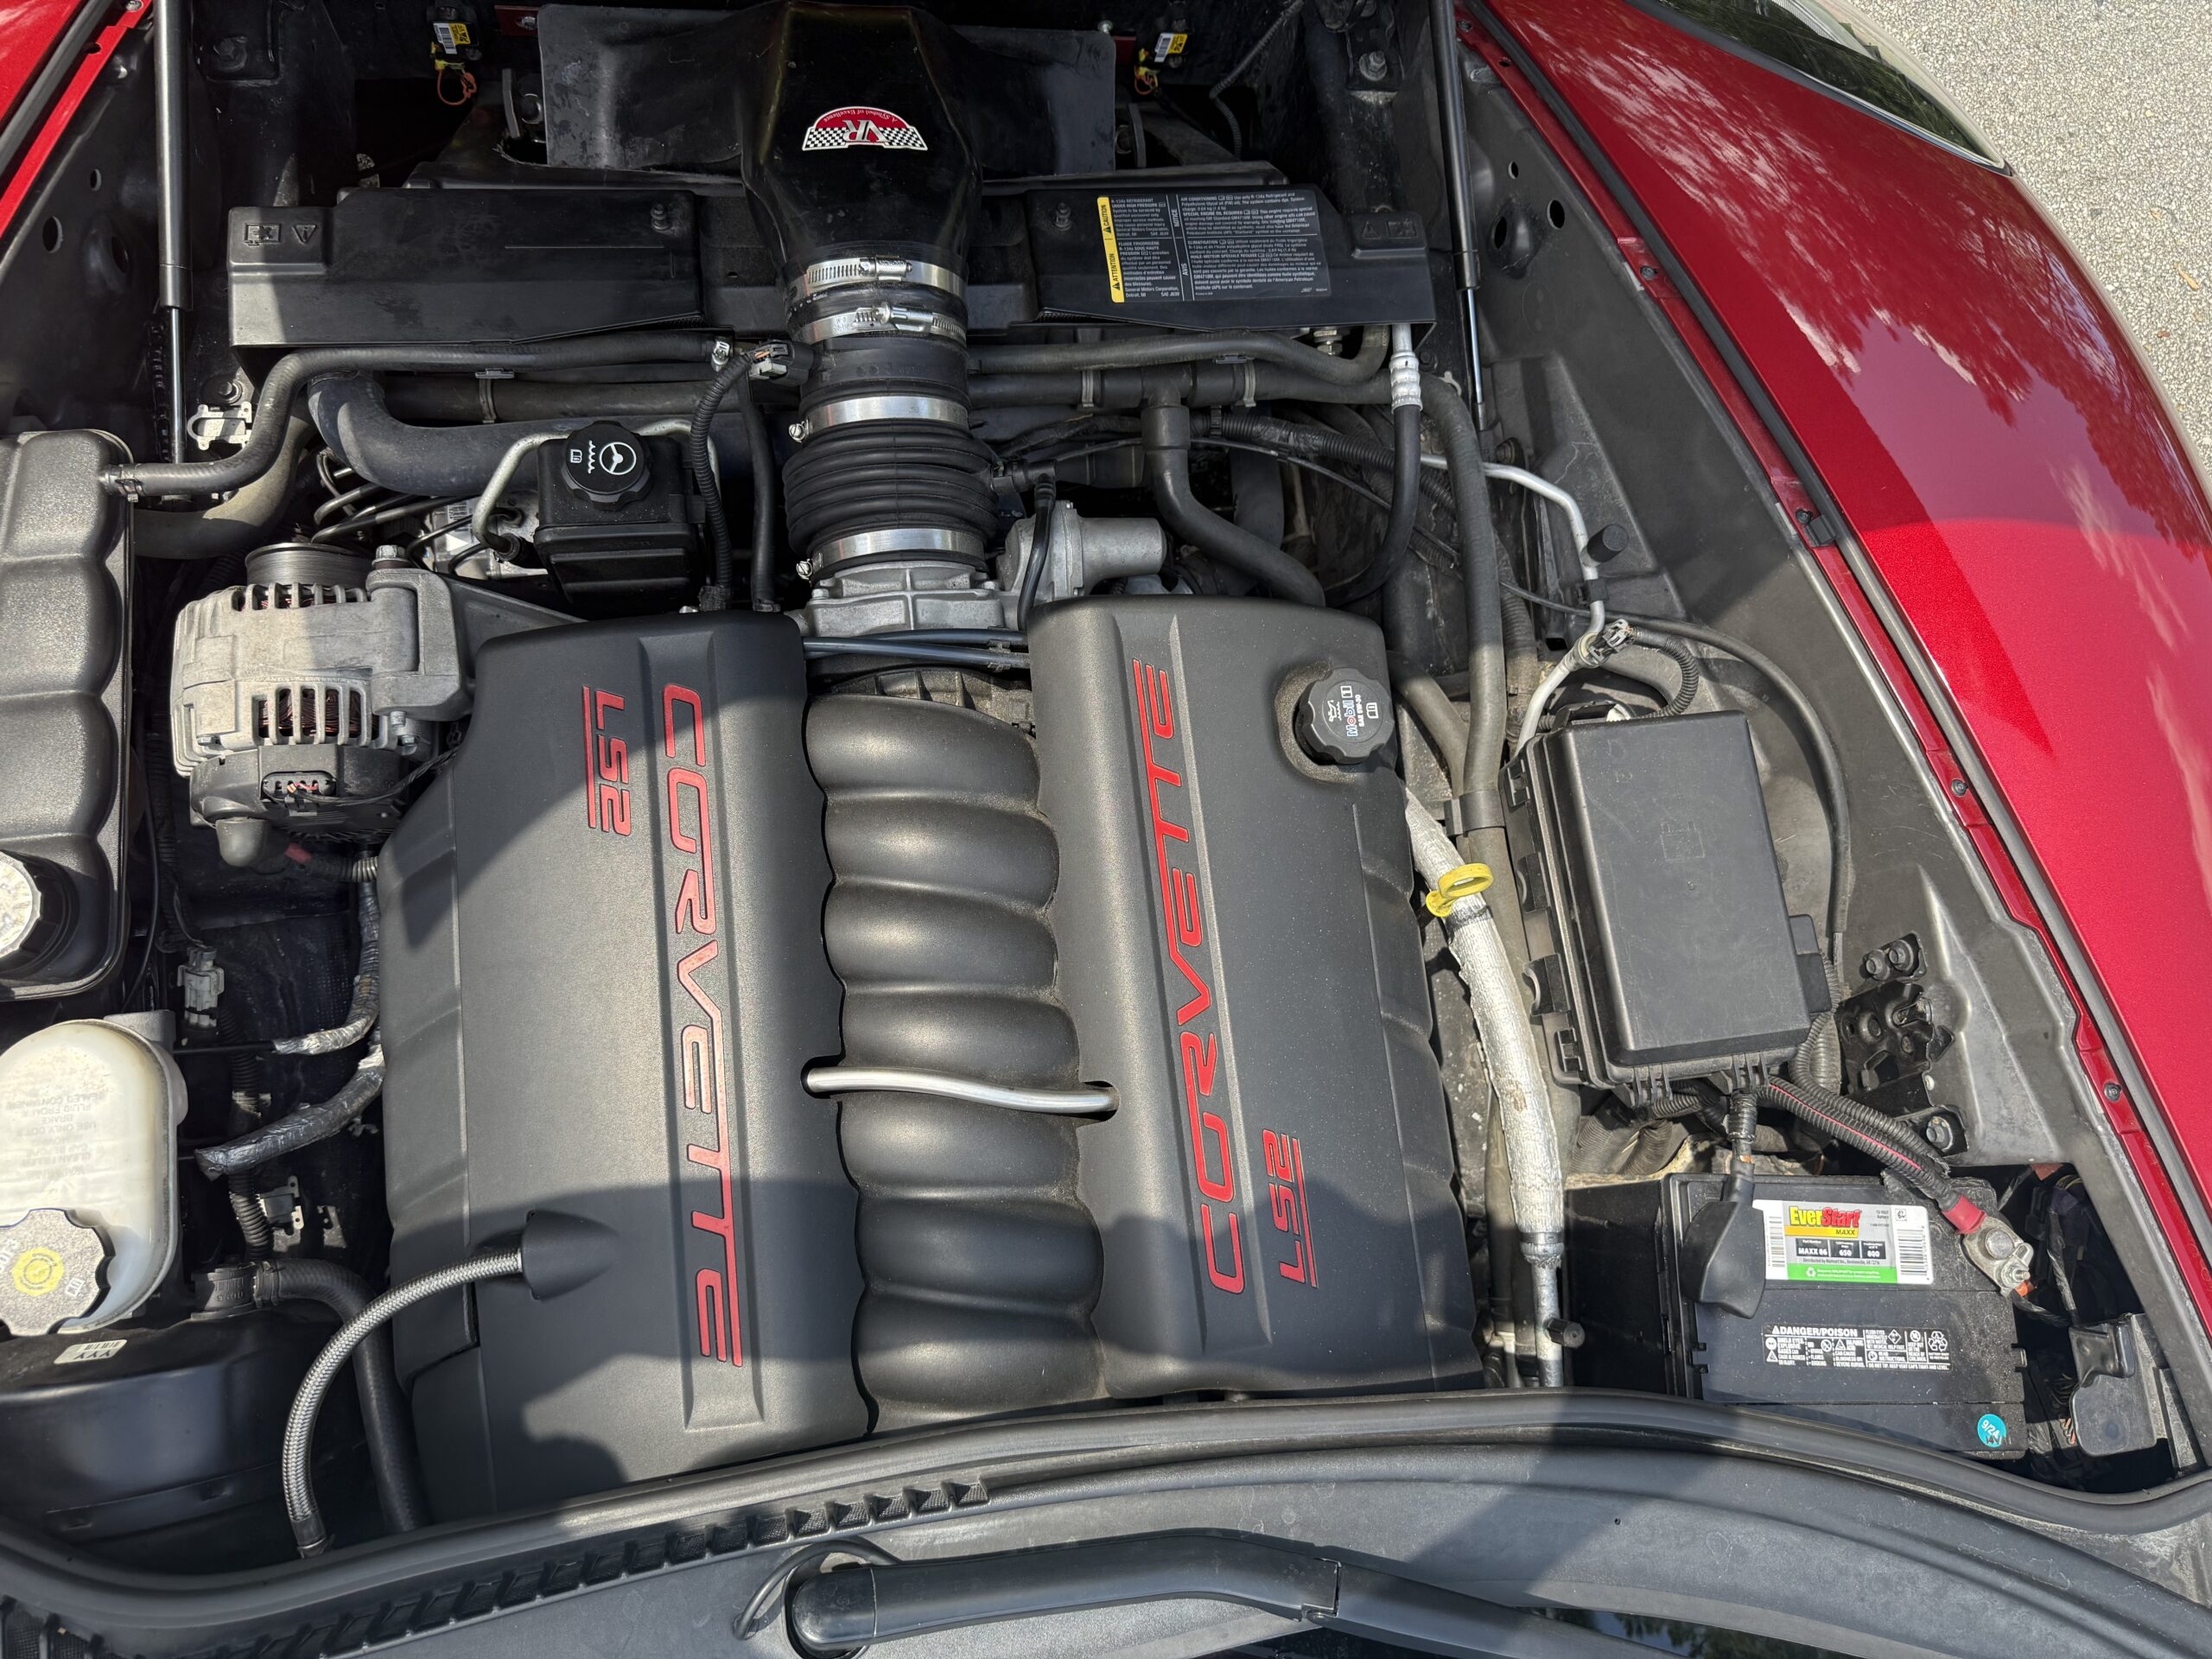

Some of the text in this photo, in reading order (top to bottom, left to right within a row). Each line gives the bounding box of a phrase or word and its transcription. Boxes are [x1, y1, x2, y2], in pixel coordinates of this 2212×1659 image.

[823, 110, 856, 122] Excellence
[842, 119, 890, 142] VR
[1101, 205, 1109, 226] CAUTION
[1172, 208, 1180, 227] NOTICE
[1109, 253, 1118, 282] ATTENTION
[1180, 263, 1189, 276] AVIS
[1342, 700, 1358, 737] Mobil
[594, 686, 632, 836] LS2
[1134, 658, 1244, 1293] CORVETTE
[663, 682, 743, 1367] CORVETTE
[1262, 1128, 1306, 1283] LS2
[1789, 1205, 1860, 1228] EverStart
[1779, 1326, 1858, 1338] DANGER/POISON
[1981, 1420, 2000, 1440] 9/24
